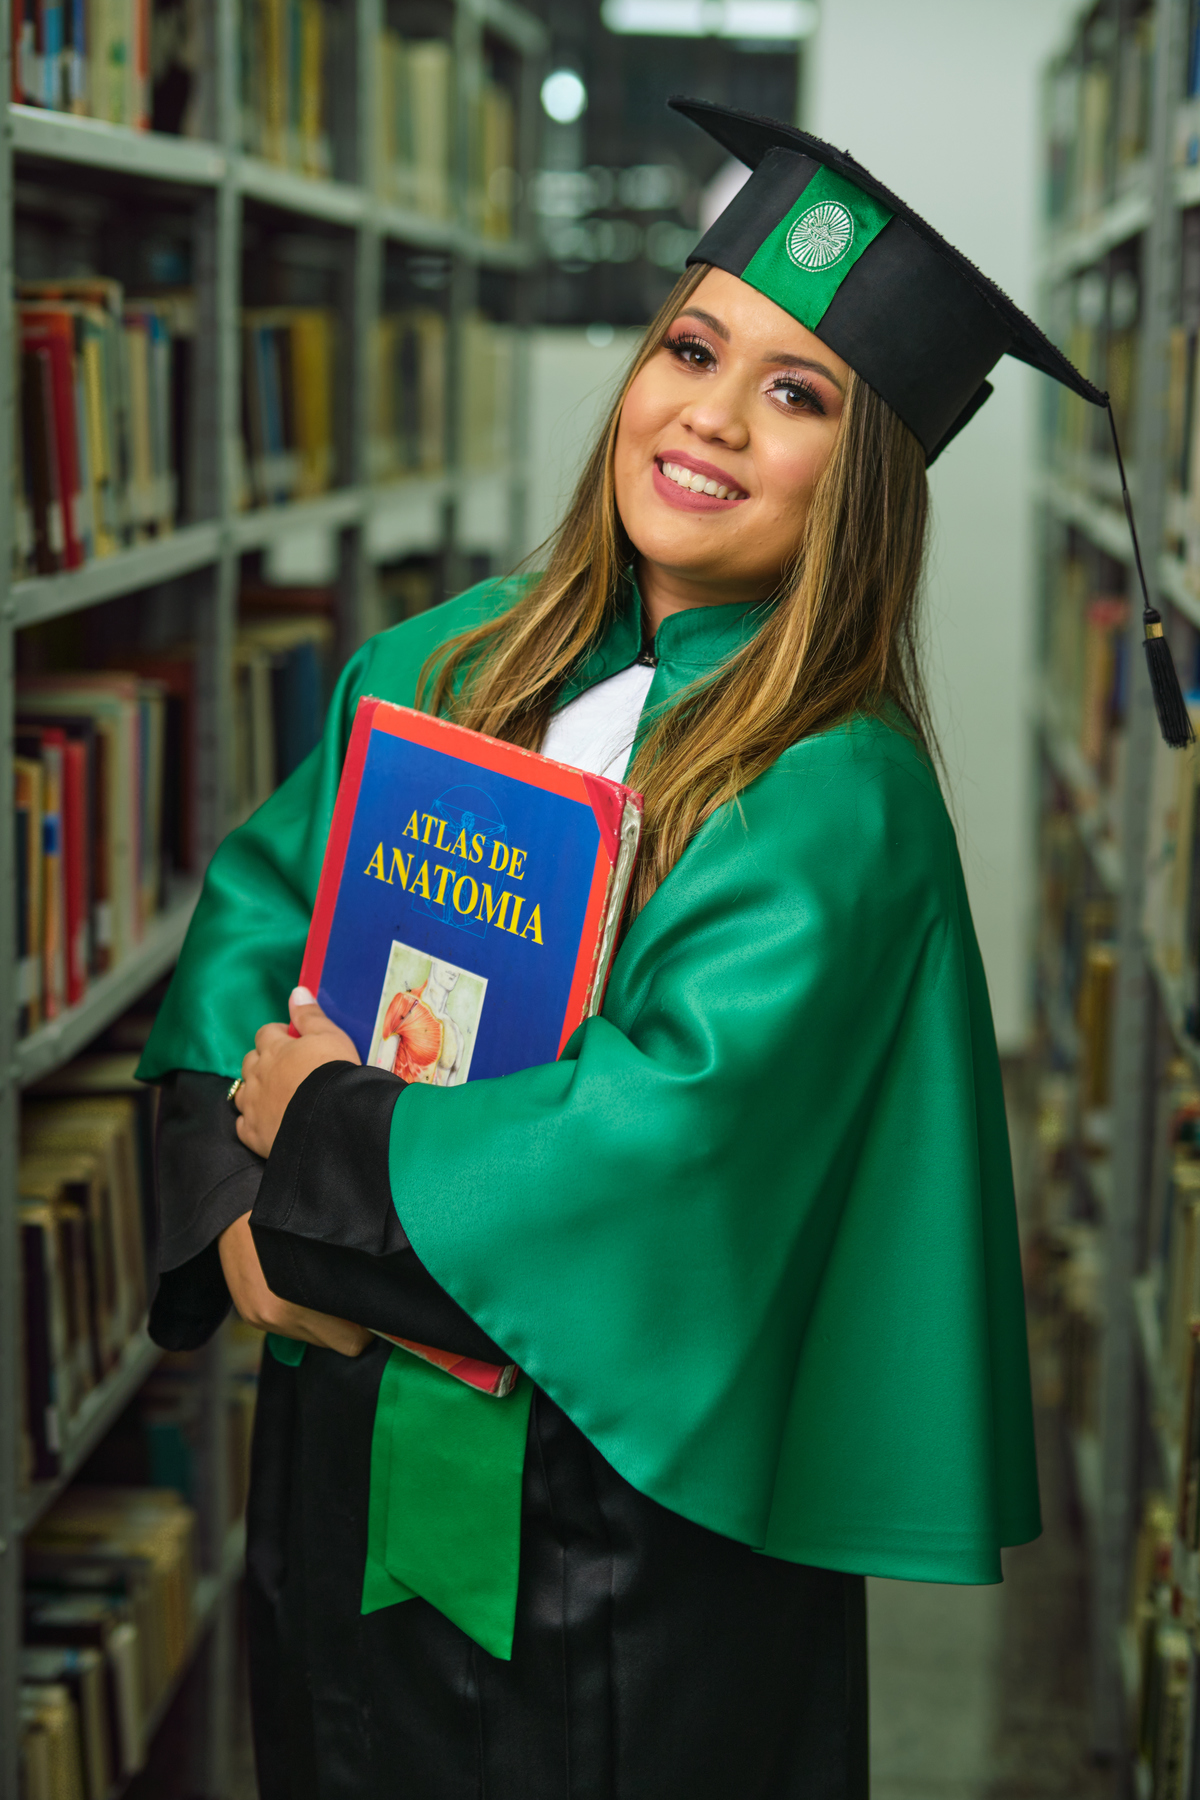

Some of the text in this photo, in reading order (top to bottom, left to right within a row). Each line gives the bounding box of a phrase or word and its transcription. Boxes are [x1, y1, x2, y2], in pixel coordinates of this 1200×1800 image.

[402, 810, 528, 880] ATLAS DE
[364, 842, 544, 945] ANATOMIA
